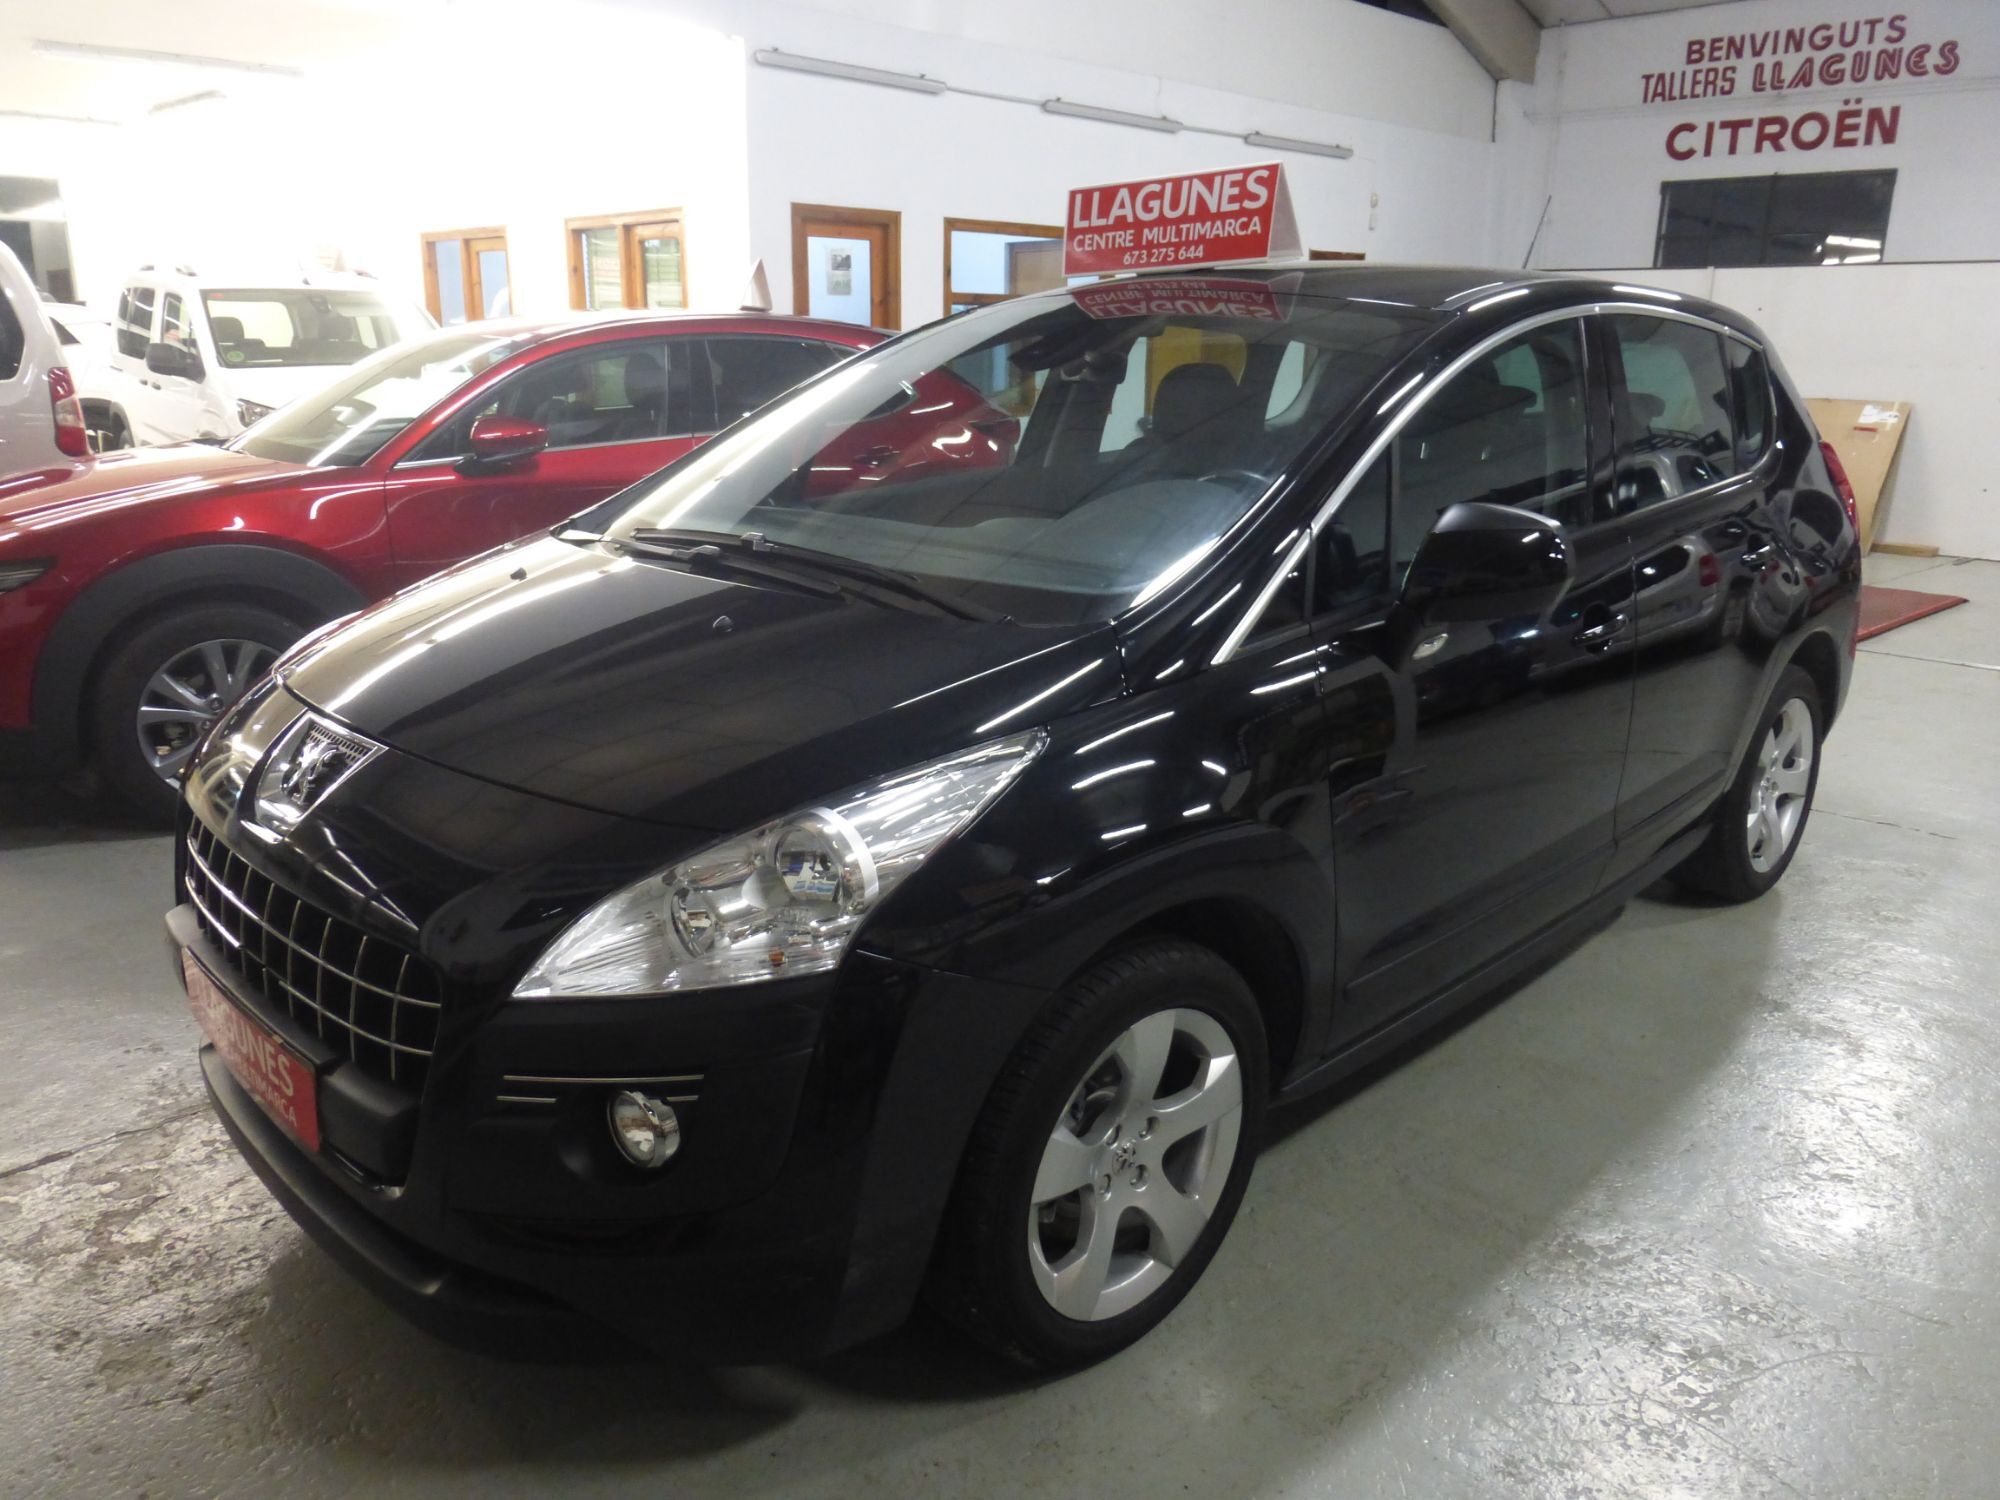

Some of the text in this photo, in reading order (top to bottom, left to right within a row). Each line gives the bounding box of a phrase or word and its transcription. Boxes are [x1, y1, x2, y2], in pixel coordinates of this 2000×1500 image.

[1686, 14, 1907, 65] BENVINGUTS
[1641, 39, 1960, 104] TALLERS LLAGUNES
[1665, 97, 1901, 161] CITROËN
[1073, 169, 1270, 229] LLAGUNES
[1073, 215, 1262, 252] CENTRE MULTIMARCA
[1123, 244, 1204, 266] 673 275 644
